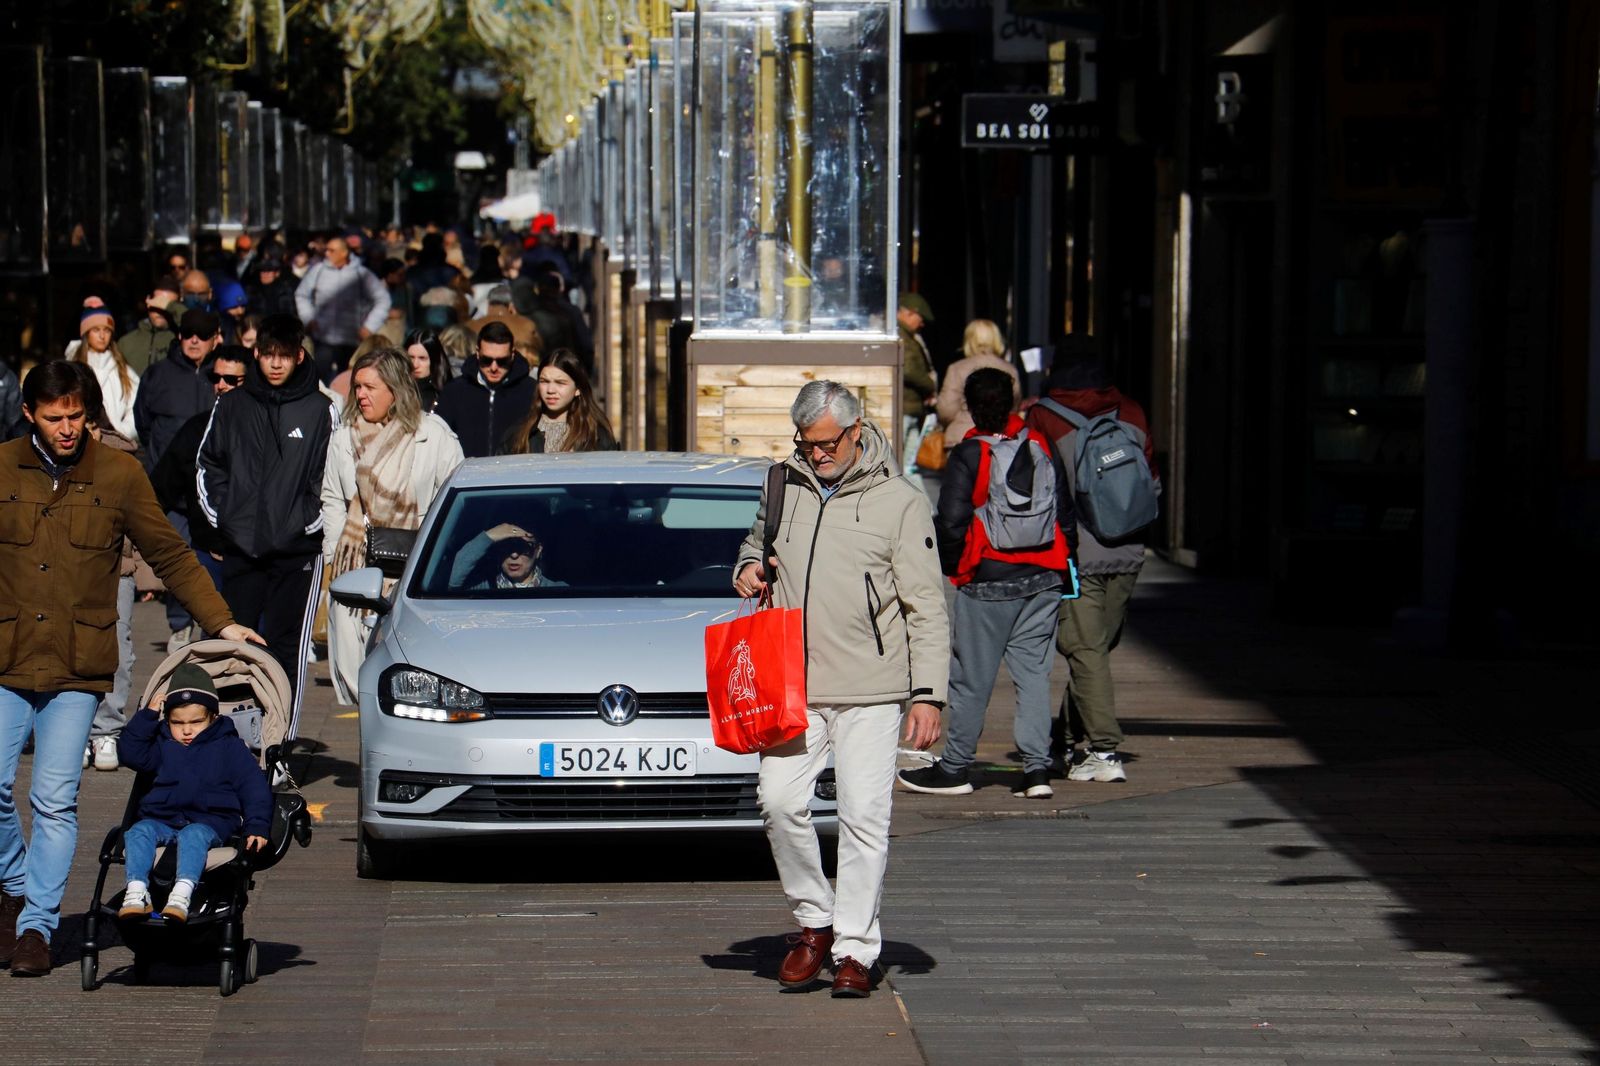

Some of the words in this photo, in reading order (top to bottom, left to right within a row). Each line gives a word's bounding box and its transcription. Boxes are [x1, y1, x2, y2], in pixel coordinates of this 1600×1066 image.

[976, 122, 1011, 139] BEA
[561, 747, 628, 772] 5024
[638, 747, 688, 772] KJC
